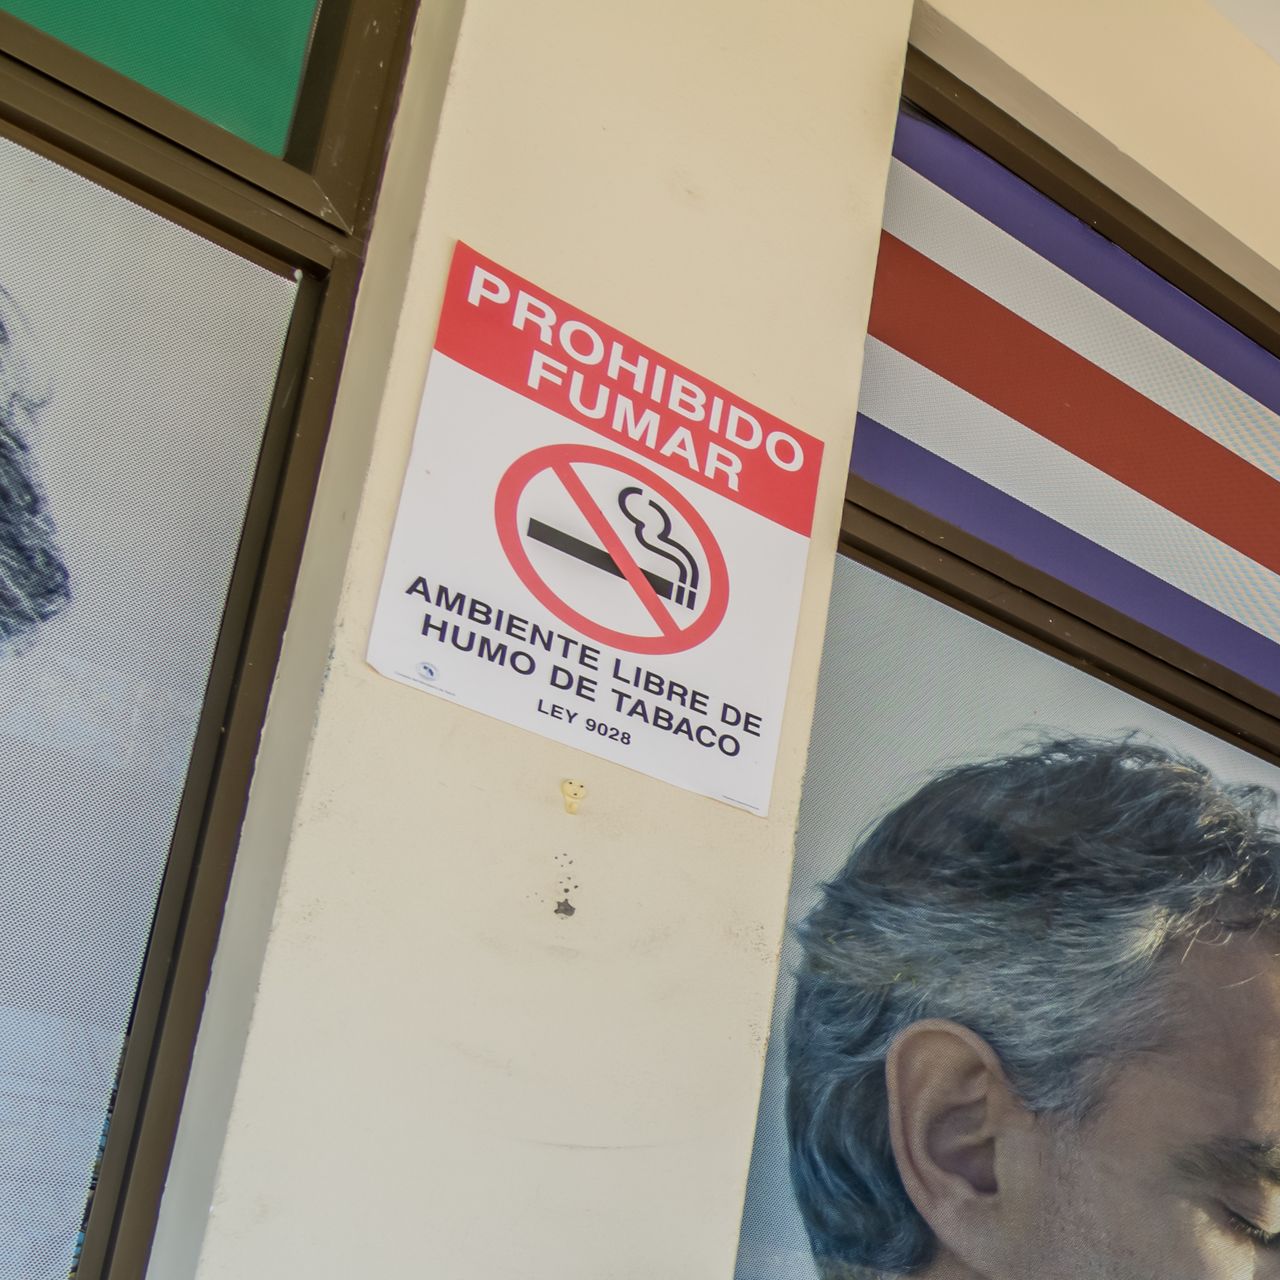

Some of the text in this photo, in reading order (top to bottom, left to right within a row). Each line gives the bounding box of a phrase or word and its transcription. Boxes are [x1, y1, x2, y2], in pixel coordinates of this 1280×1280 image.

[467, 266, 804, 472] PROHIBIDO
[527, 351, 743, 492] FUMAR
[406, 576, 763, 737] AMBIENTE LIBRE DE
[421, 613, 740, 757] HUMO DE TABACO
[537, 699, 631, 746] LEY 9028
